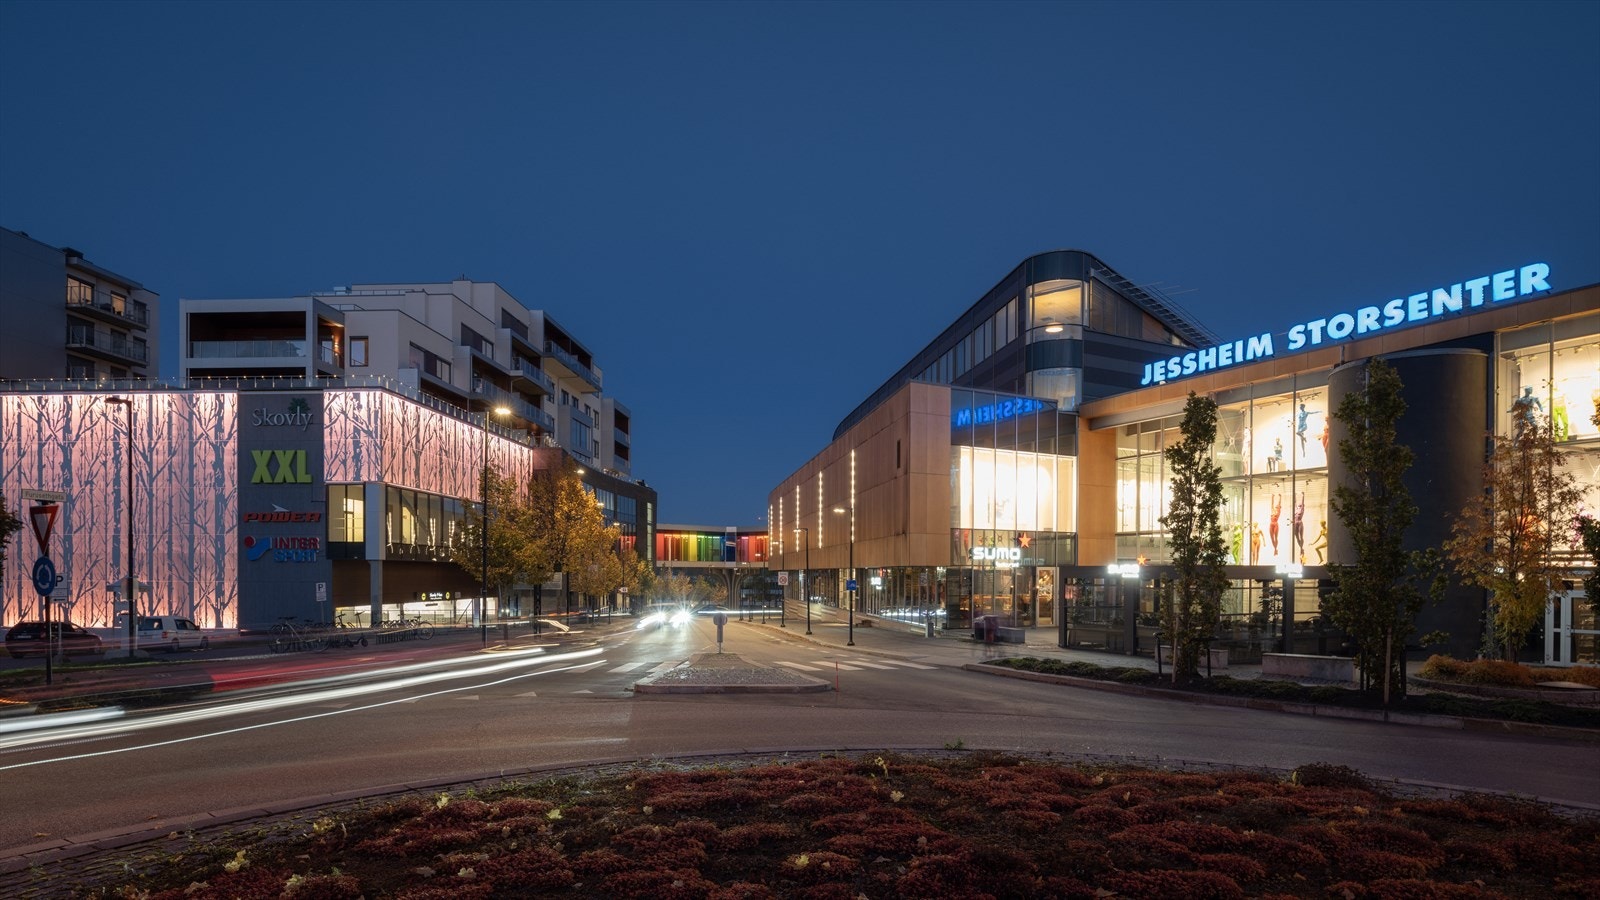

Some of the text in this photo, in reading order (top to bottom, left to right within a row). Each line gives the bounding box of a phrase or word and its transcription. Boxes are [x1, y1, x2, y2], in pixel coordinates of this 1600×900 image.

[1141, 262, 1553, 386] JESSHEIM STORSENTER
[252, 406, 313, 432] Skovly
[251, 450, 312, 483] XXL
[243, 511, 321, 523] POWER
[274, 537, 320, 550] INTER
[273, 550, 317, 562] SPORT
[55, 575, 64, 587] P
[318, 583, 324, 592] P
